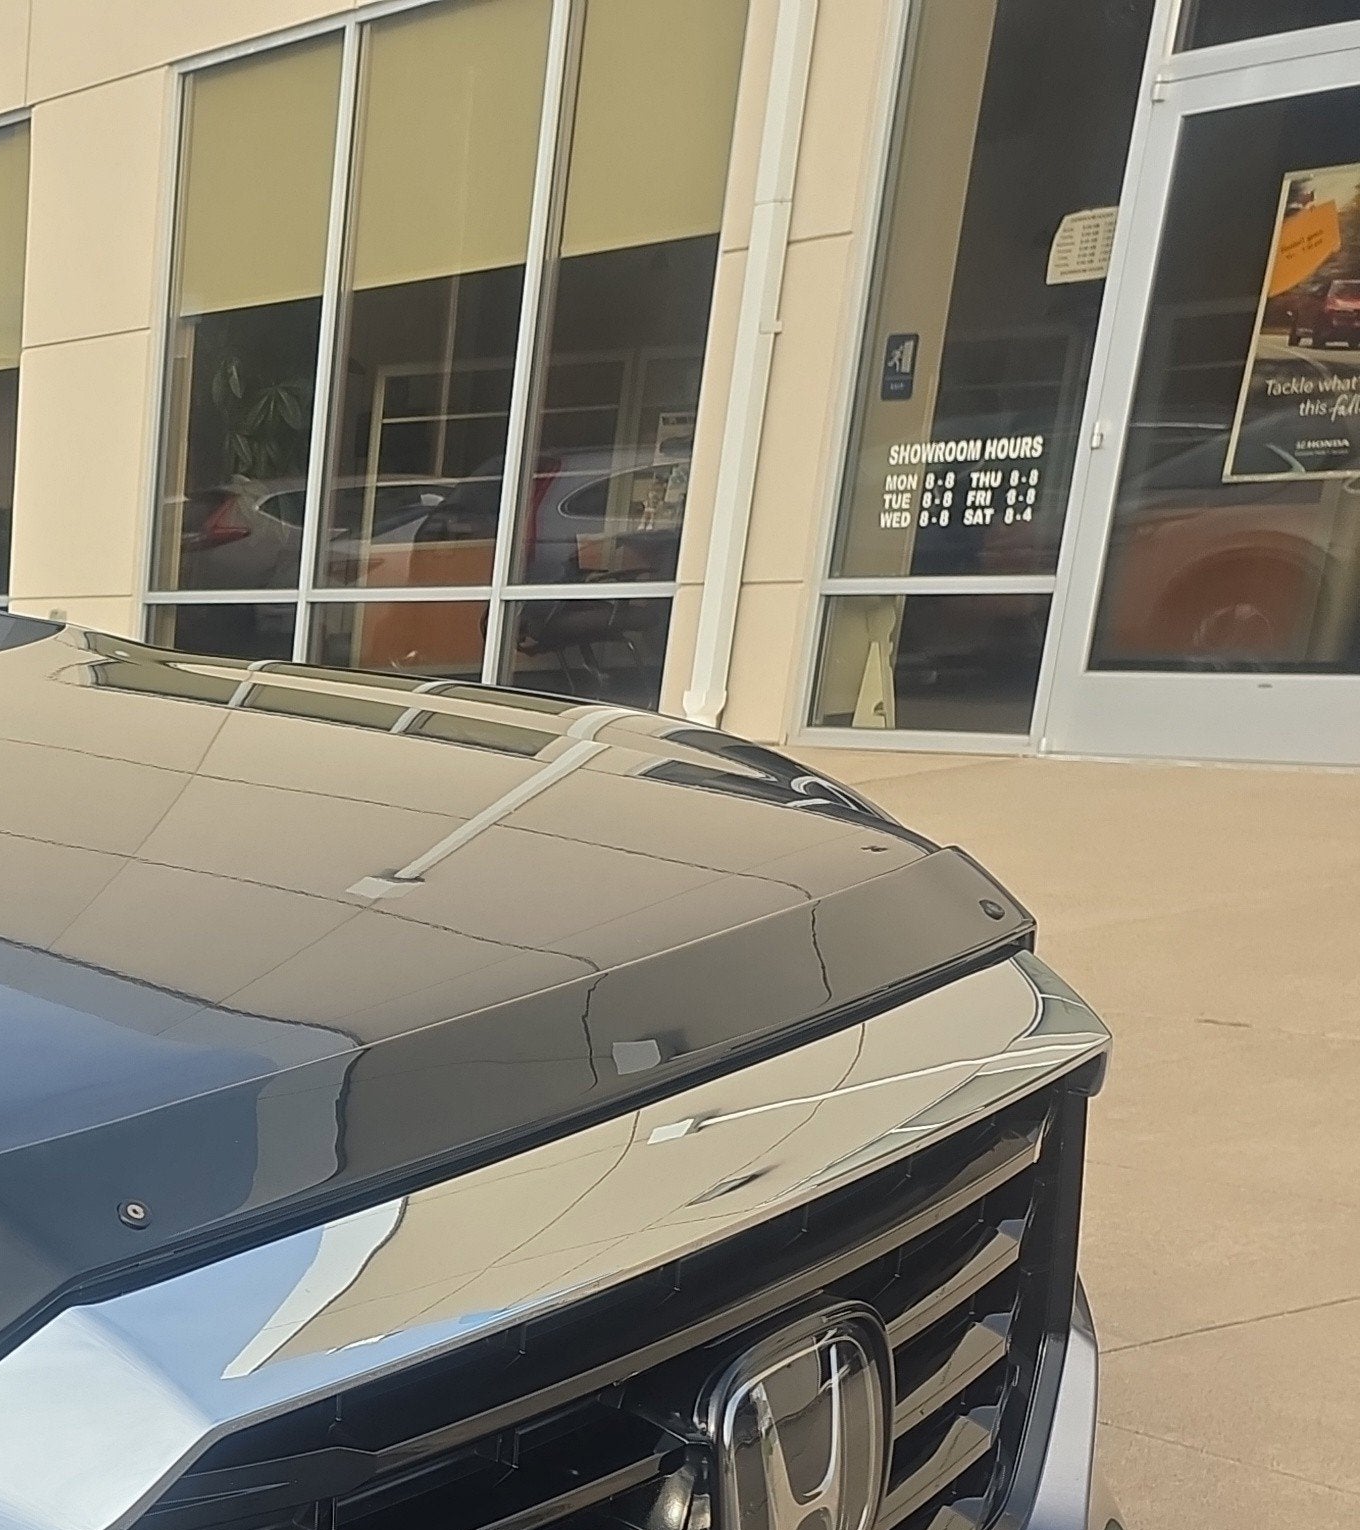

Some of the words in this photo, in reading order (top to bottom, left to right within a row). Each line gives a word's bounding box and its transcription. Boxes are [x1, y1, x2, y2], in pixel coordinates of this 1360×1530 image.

[1265, 376, 1314, 396] Tackle
[1299, 398, 1327, 416] this
[888, 439, 982, 465] SHOWROOM
[984, 435, 1044, 460] HOURS
[885, 474, 918, 491] MON
[925, 472, 955, 490] 8-8
[970, 470, 1002, 488] THU
[1009, 469, 1039, 487] 8-8
[883, 492, 911, 510] TUE
[922, 490, 953, 509] 8-8
[966, 489, 992, 507] FRI
[1006, 488, 1036, 506] 8-8
[880, 511, 911, 529] WED
[919, 509, 950, 527] 8-8
[963, 508, 995, 526] SAT
[1004, 506, 1032, 524] 8-4
